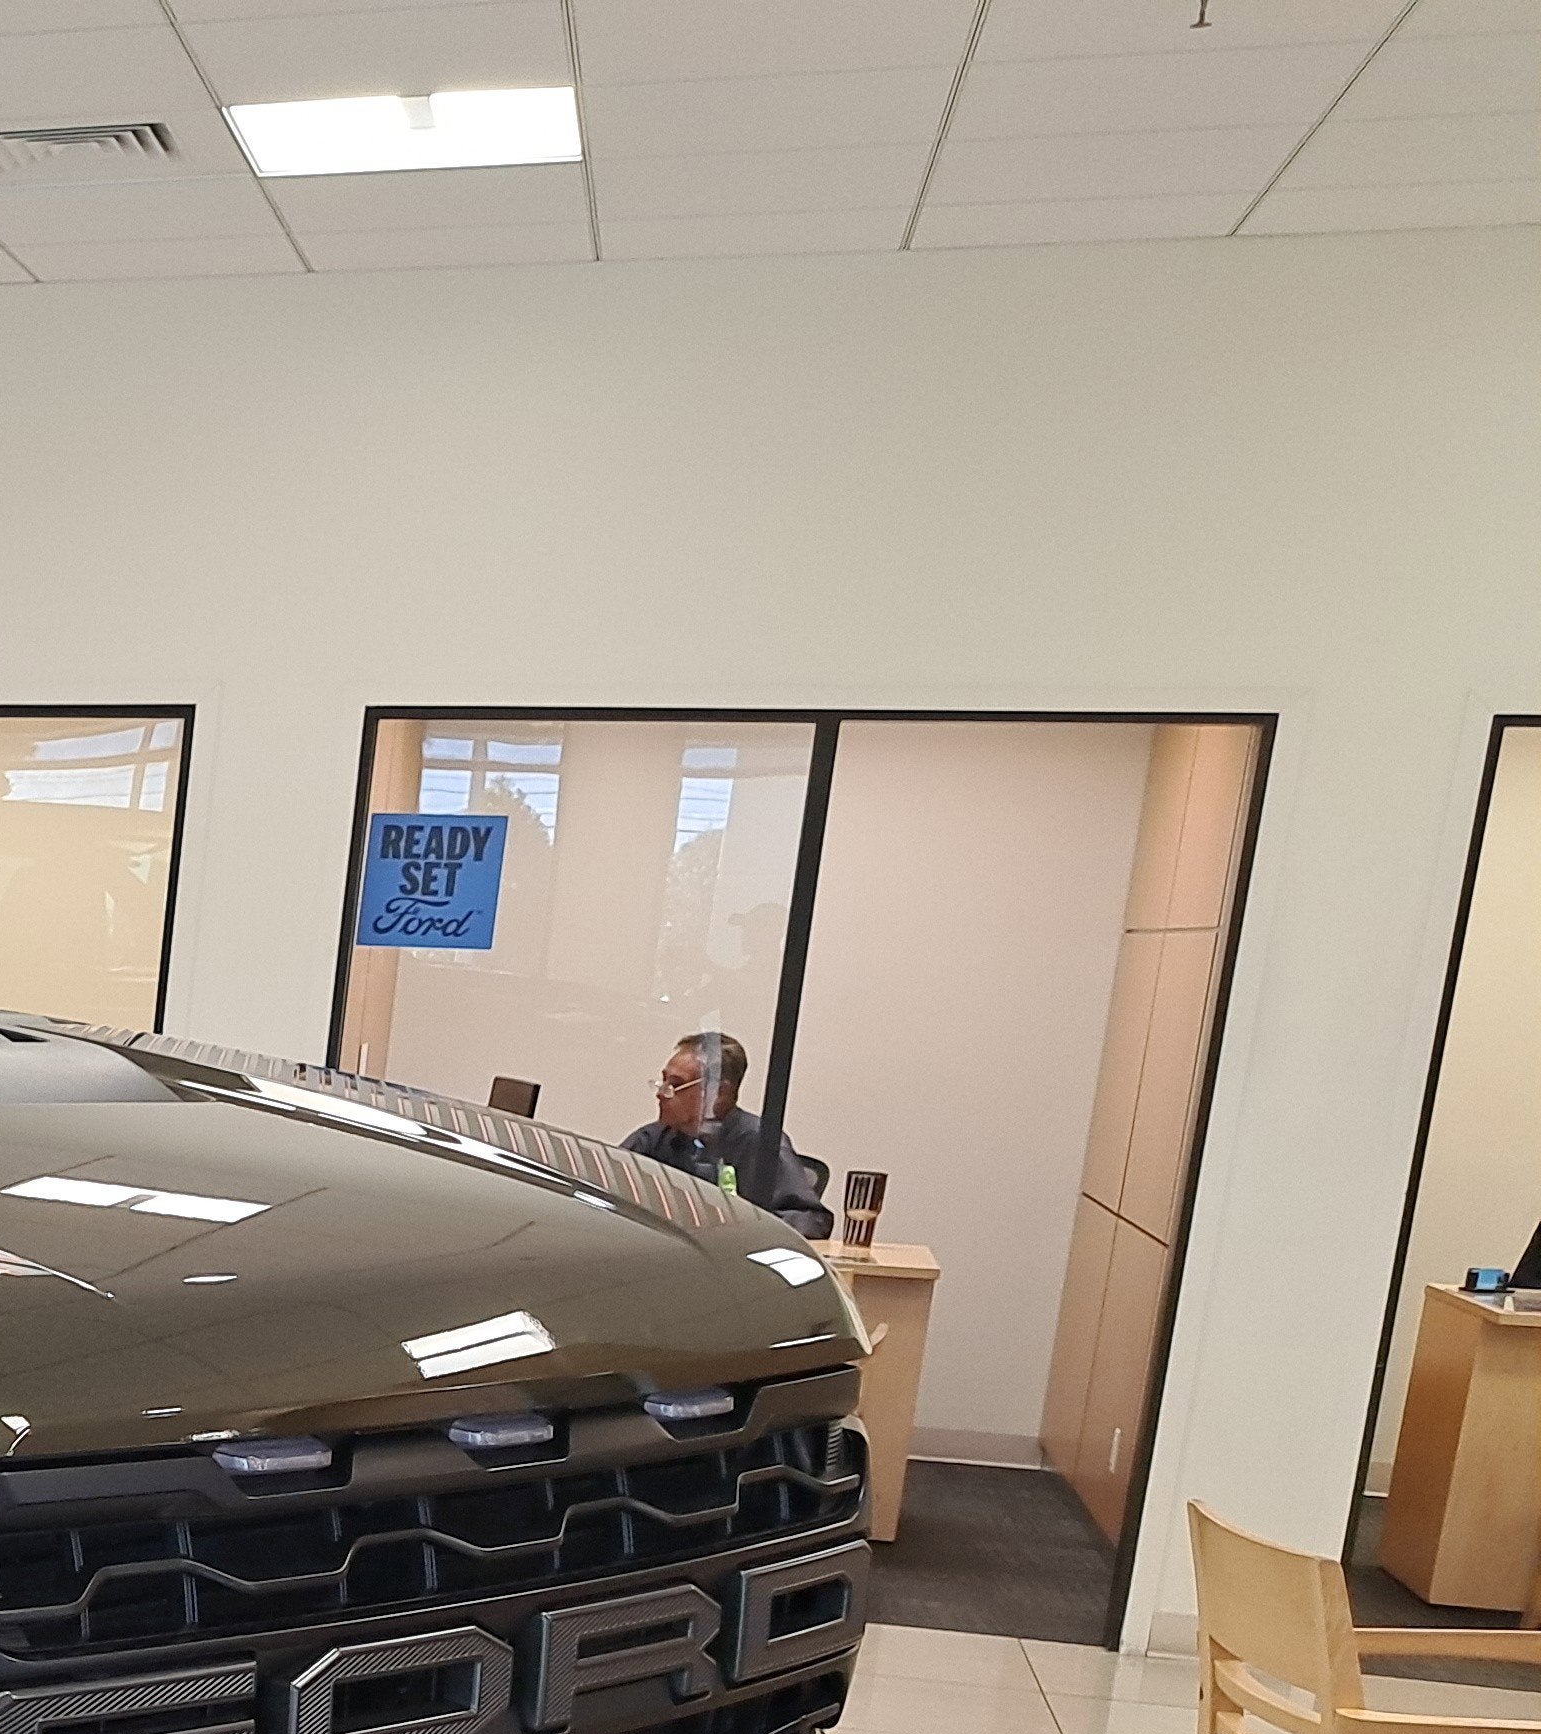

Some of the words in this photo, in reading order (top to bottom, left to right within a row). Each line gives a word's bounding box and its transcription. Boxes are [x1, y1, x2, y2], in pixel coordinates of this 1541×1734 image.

[380, 824, 493, 861] READY
[399, 860, 462, 897] SET
[372, 897, 474, 937] Ford
